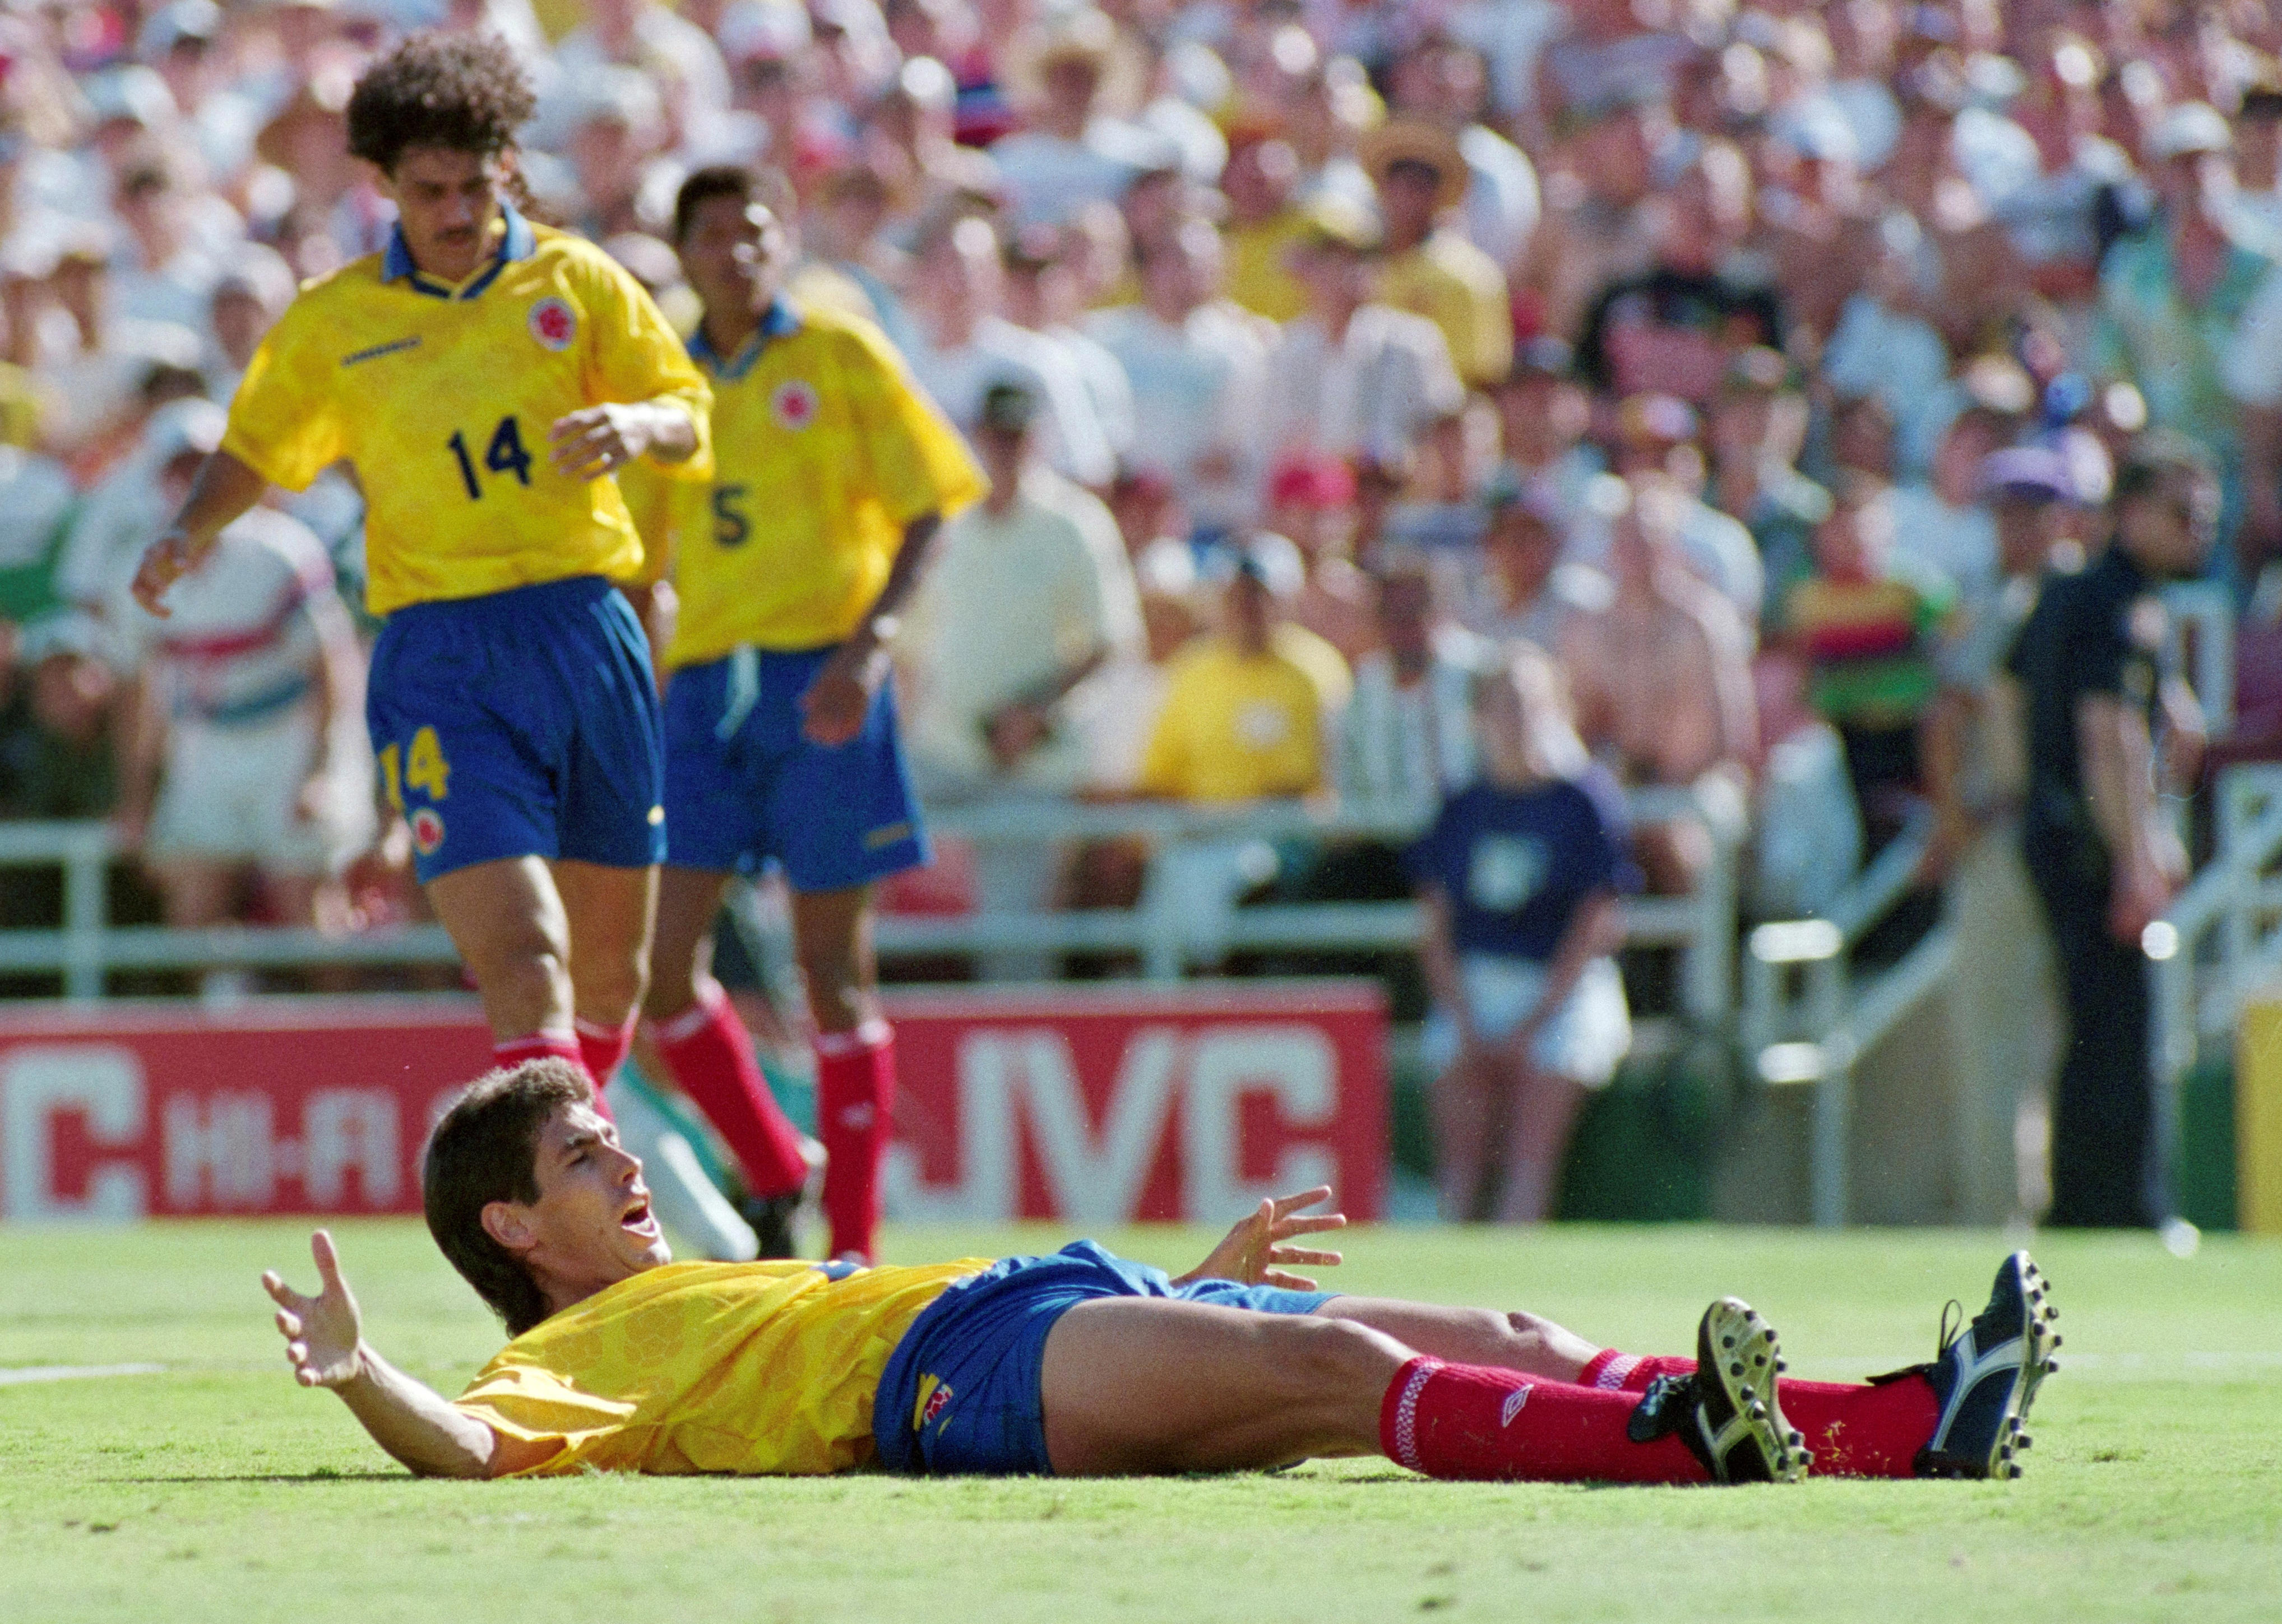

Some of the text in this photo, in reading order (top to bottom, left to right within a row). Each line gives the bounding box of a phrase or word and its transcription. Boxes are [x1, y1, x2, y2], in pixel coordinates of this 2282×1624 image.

[447, 415, 533, 498] 14
[711, 482, 750, 547] 5
[378, 726, 450, 808] 14
[881, 1027, 1337, 1224] JVC
